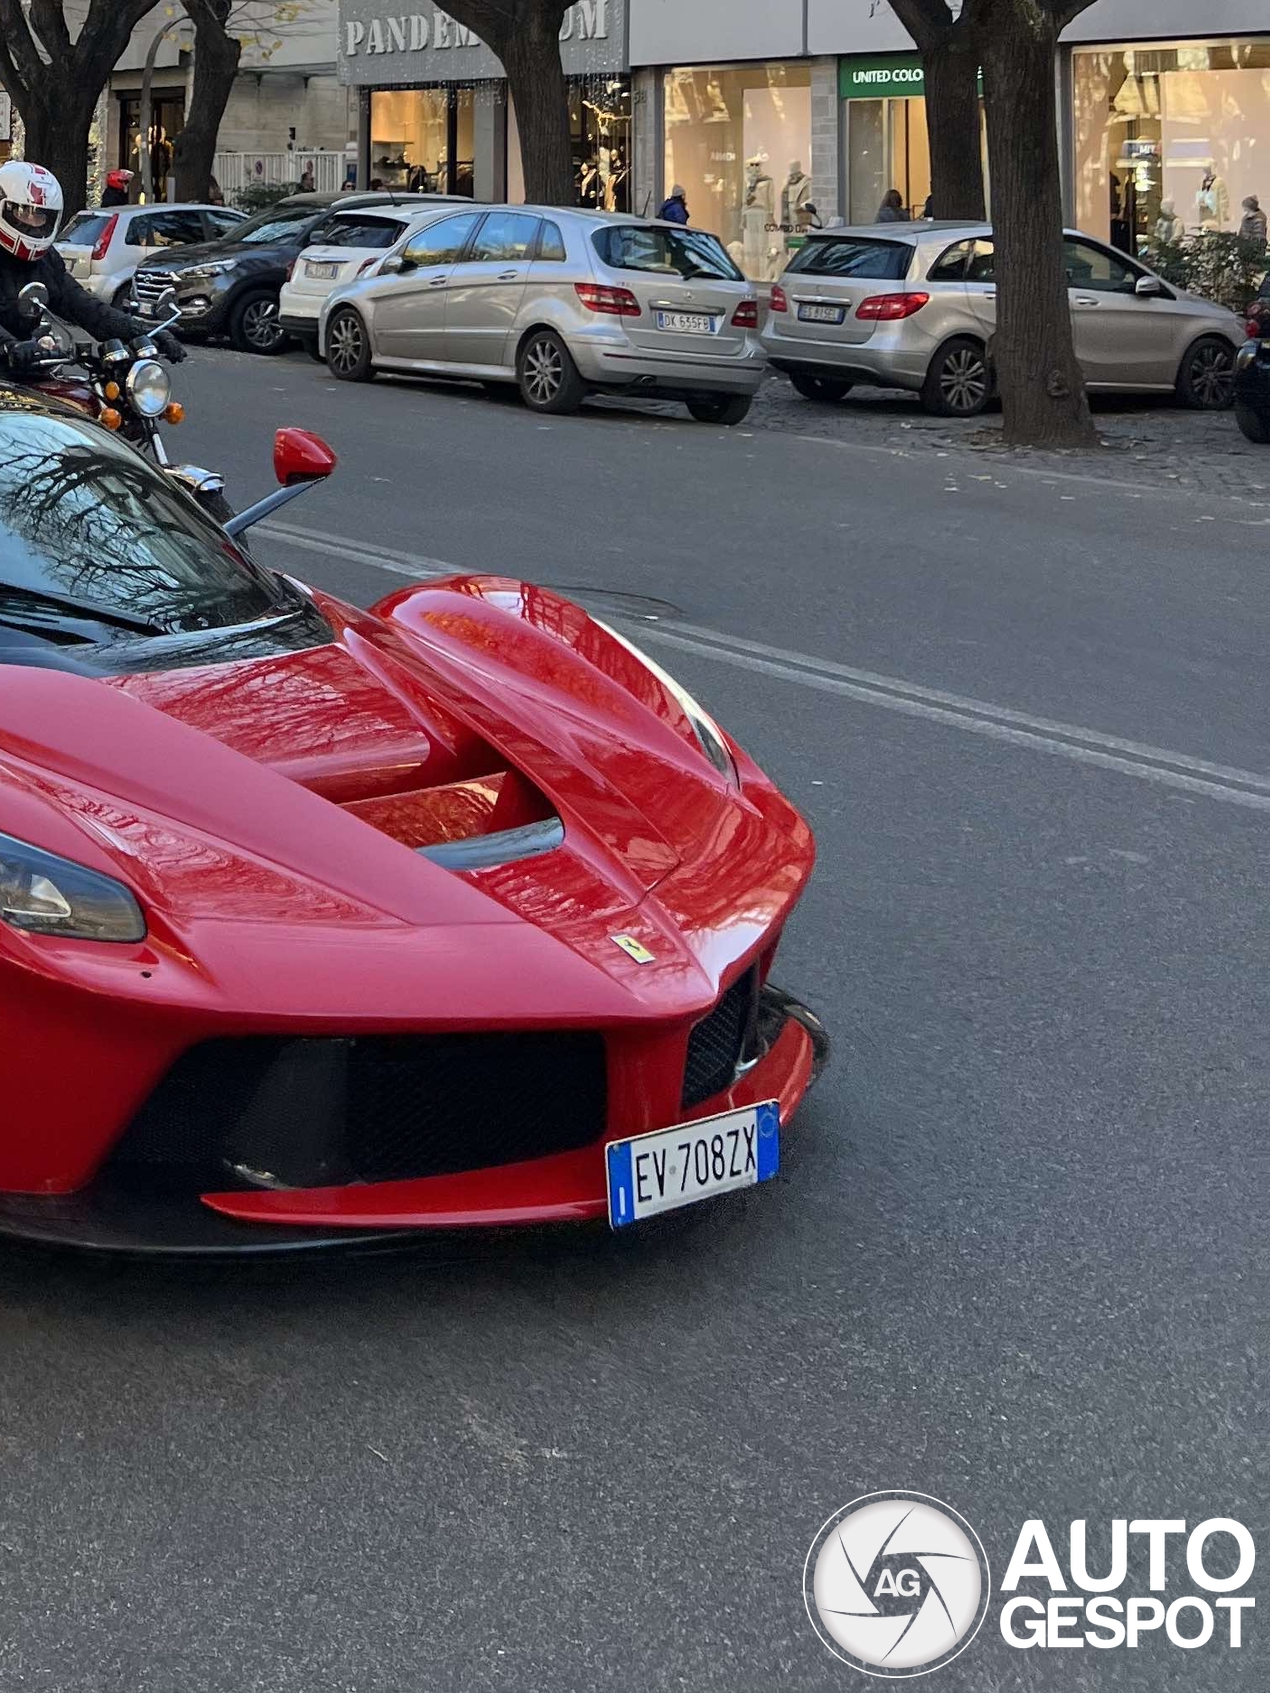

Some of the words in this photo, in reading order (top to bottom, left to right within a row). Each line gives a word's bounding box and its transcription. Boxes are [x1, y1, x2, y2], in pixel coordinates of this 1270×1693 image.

[852, 70, 891, 84] UNITED
[892, 68, 924, 82] COLO
[665, 314, 677, 327] DK
[635, 1148, 666, 1203] EV
[678, 1124, 756, 1192] 708ZX
